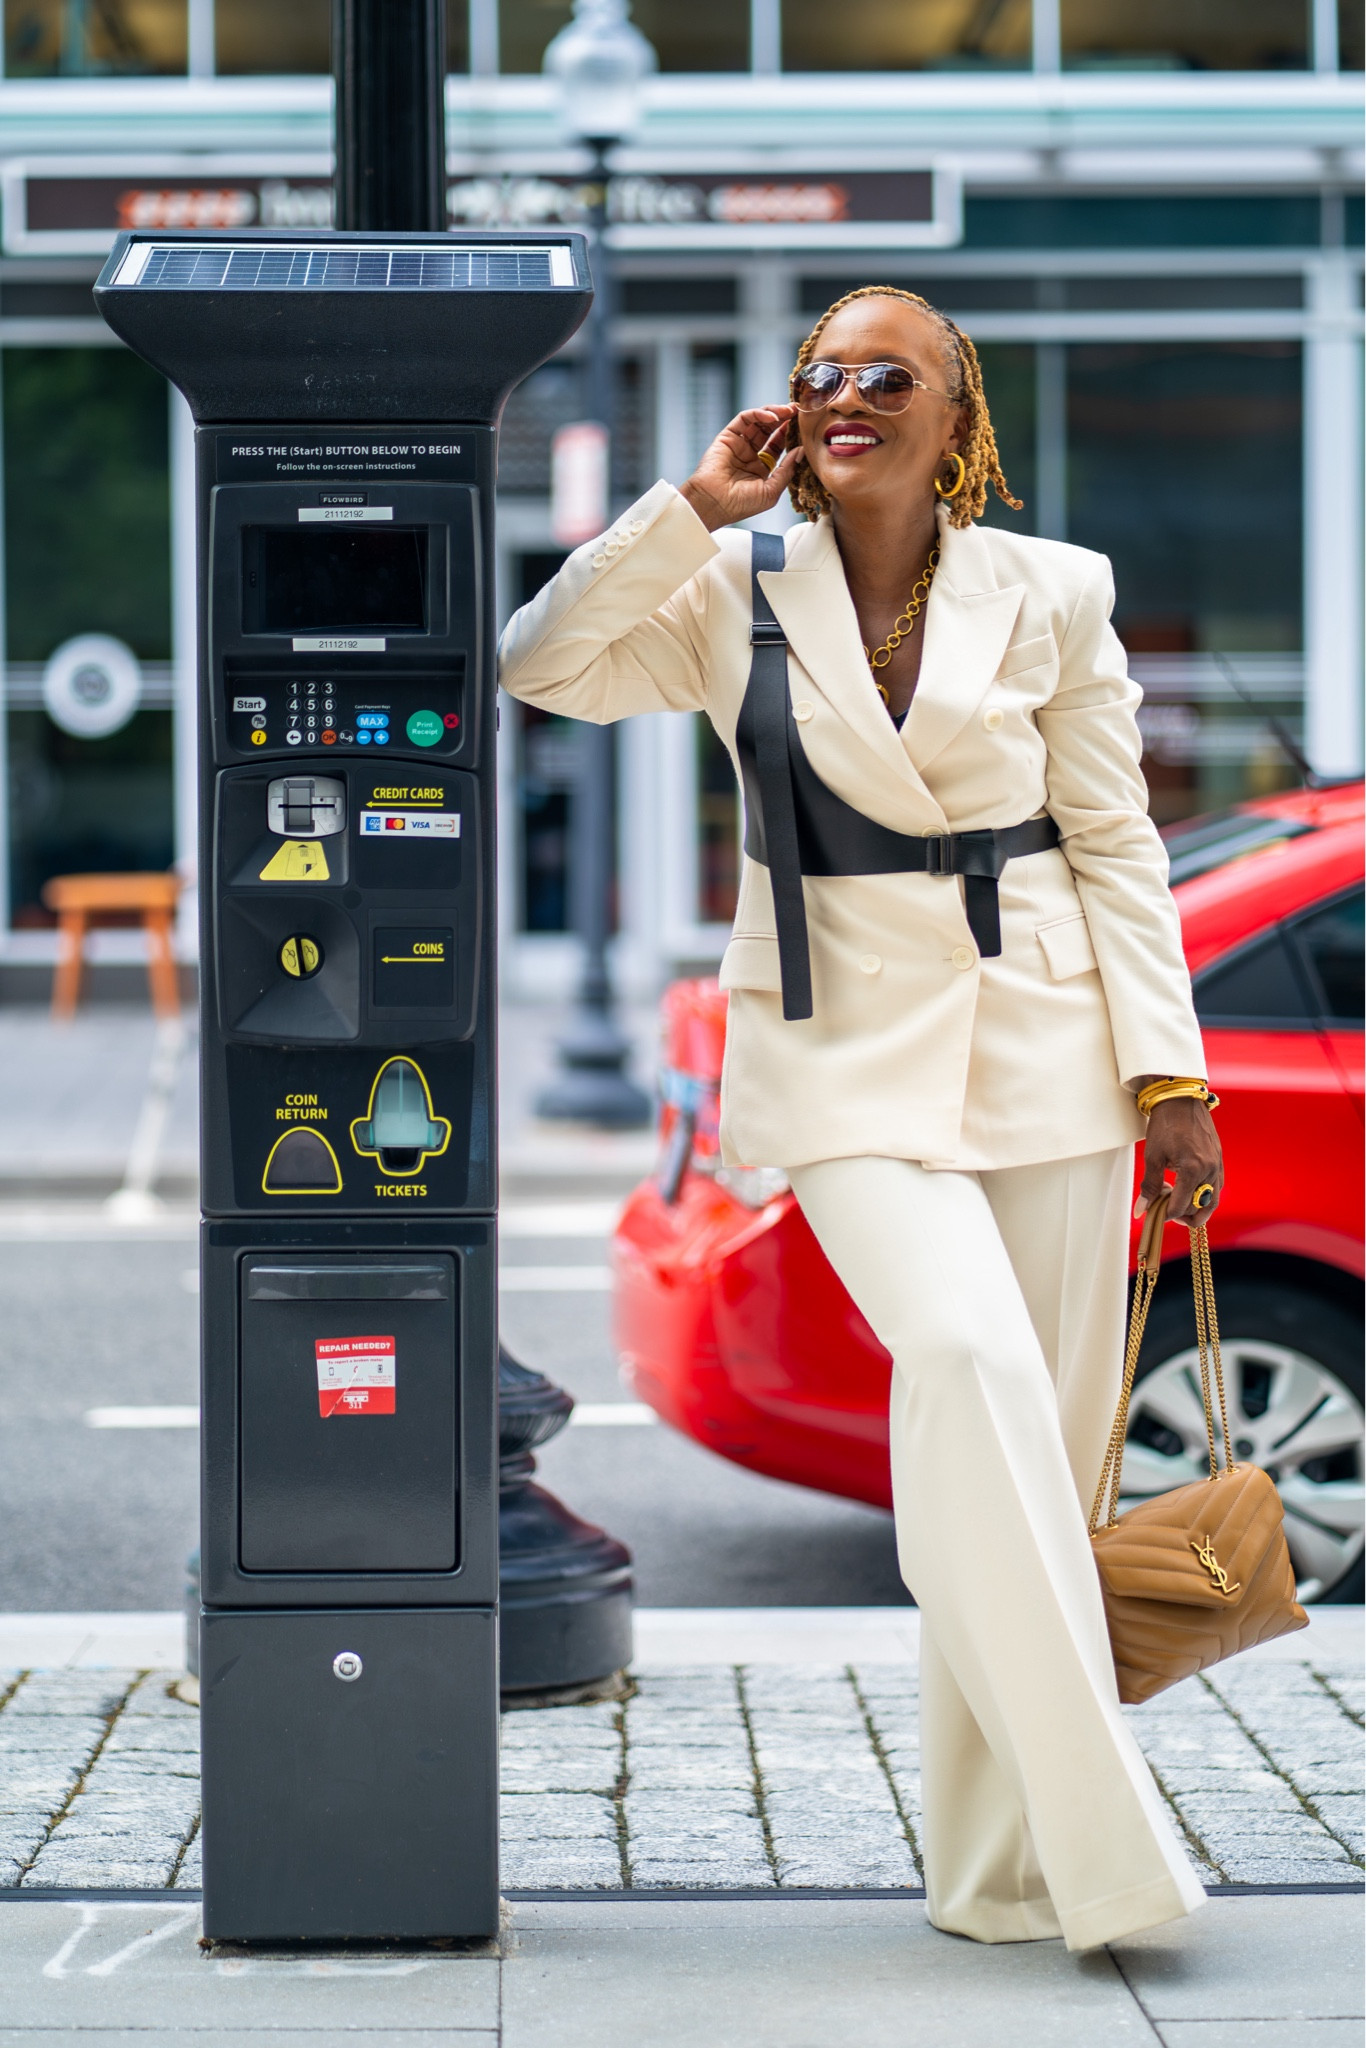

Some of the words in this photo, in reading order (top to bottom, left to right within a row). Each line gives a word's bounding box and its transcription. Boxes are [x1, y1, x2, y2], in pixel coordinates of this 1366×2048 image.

[232, 447, 264, 456] PRESS
[267, 447, 287, 456] THE
[290, 446, 323, 456] (Start)
[326, 446, 369, 455] BUTTON
[372, 446, 409, 455] BELOW
[411, 446, 426, 455] TO
[428, 445, 461, 455] BEGIN
[366, 462, 416, 470] instructions
[325, 510, 363, 518] 21112192
[319, 641, 358, 649] 21112192
[291, 683, 297, 694] 1
[307, 683, 316, 694] 2
[325, 683, 333, 694] 3
[237, 700, 262, 709] Start
[289, 699, 298, 710] 4
[307, 699, 316, 710] 5
[325, 699, 333, 710] 6
[289, 716, 298, 727] 7
[307, 716, 316, 727] 8
[325, 716, 333, 727] 9
[360, 717, 384, 726] MAX
[307, 732, 316, 743] 0
[373, 787, 408, 799] CREDIT
[410, 788, 444, 800] CARDS
[411, 821, 430, 829] VISA
[413, 943, 444, 955] COINS
[285, 1094, 318, 1106] COIN
[276, 1108, 328, 1120] RETURN
[375, 1185, 428, 1197] TICKETS
[319, 1344, 350, 1352] REPAIR
[352, 1342, 391, 1350] NEEDED?
[1190, 1534, 1240, 1595] YSL
